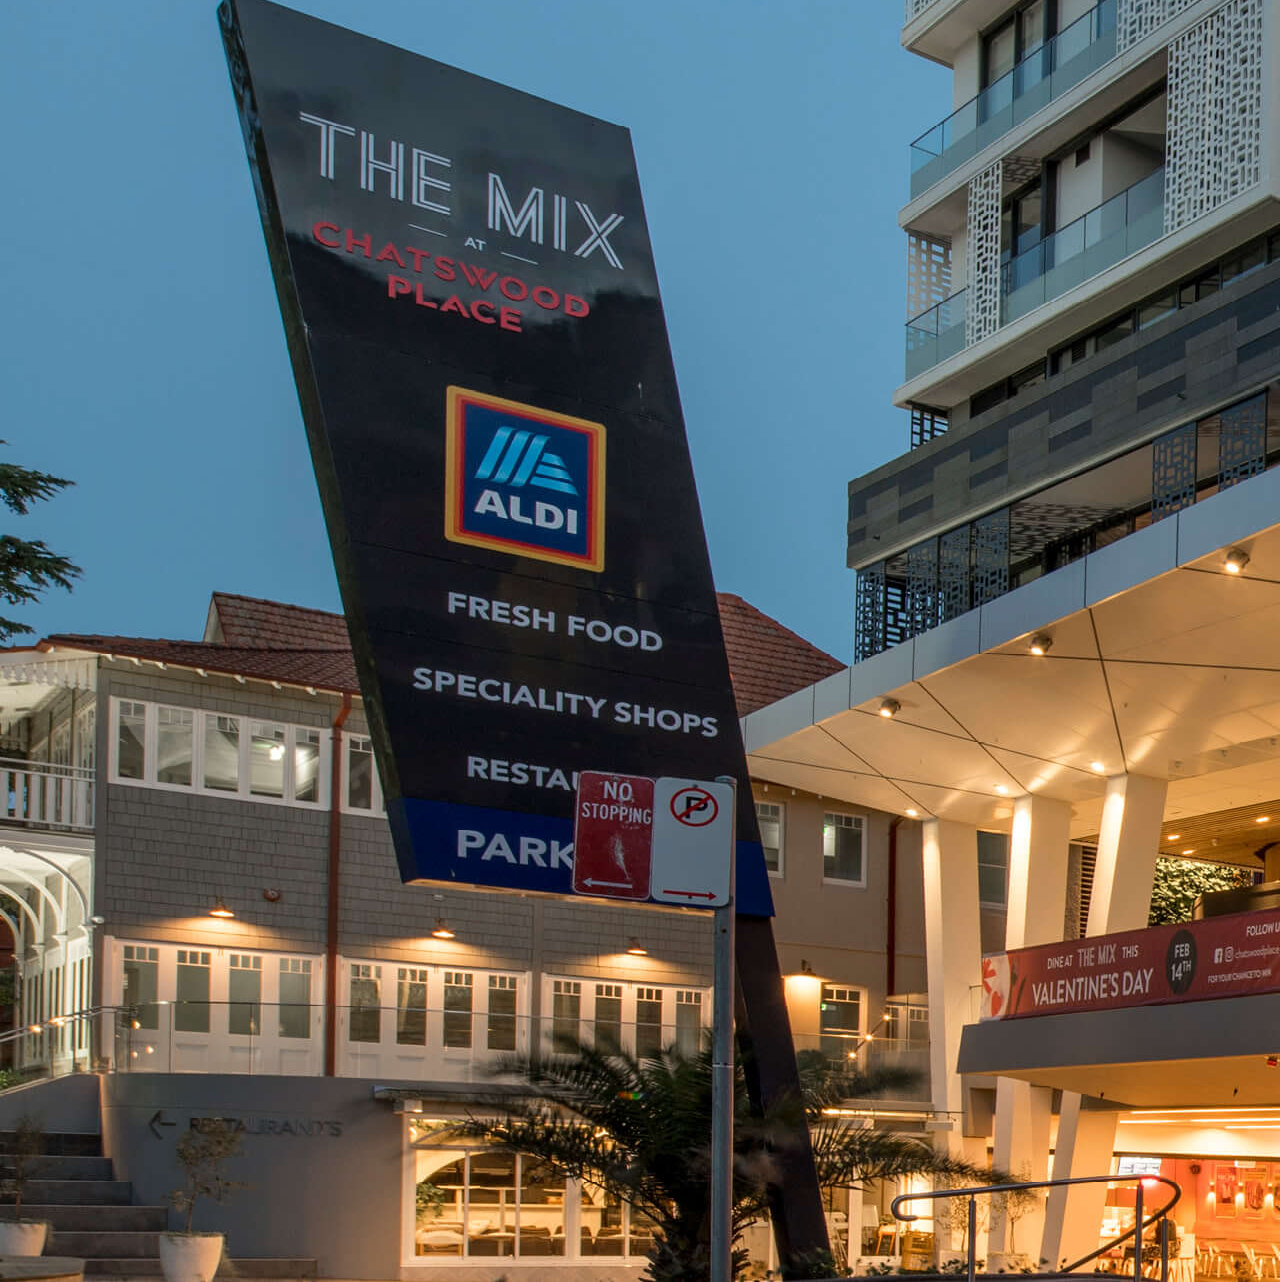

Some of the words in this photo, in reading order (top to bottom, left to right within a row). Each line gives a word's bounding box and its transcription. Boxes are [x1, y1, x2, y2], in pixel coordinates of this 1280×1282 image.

[299, 111, 451, 215] THE
[488, 172, 625, 270] MIX
[464, 237, 486, 252] AT
[311, 221, 591, 318] CHATSWOOD
[387, 274, 523, 333] PLACE
[474, 489, 578, 535] ALDI
[448, 591, 555, 632] FRESH
[567, 616, 663, 652] FOOD
[412, 668, 607, 719] SPECIALITY
[614, 702, 719, 738] SHOPS
[603, 781, 633, 802] NO
[582, 802, 652, 824] STOPPING
[1246, 923, 1274, 937] FOLLOW
[1047, 957, 1064, 969] DINE
[1064, 955, 1073, 967] AT
[1077, 947, 1095, 968] THE
[1097, 944, 1117, 965] MIX
[1122, 945, 1139, 959] THIS
[1174, 943, 1190, 958] FEB
[1032, 972, 1120, 1007] VALENTINE'S
[1122, 968, 1154, 996] DAY
[1170, 961, 1192, 982] 14TH
